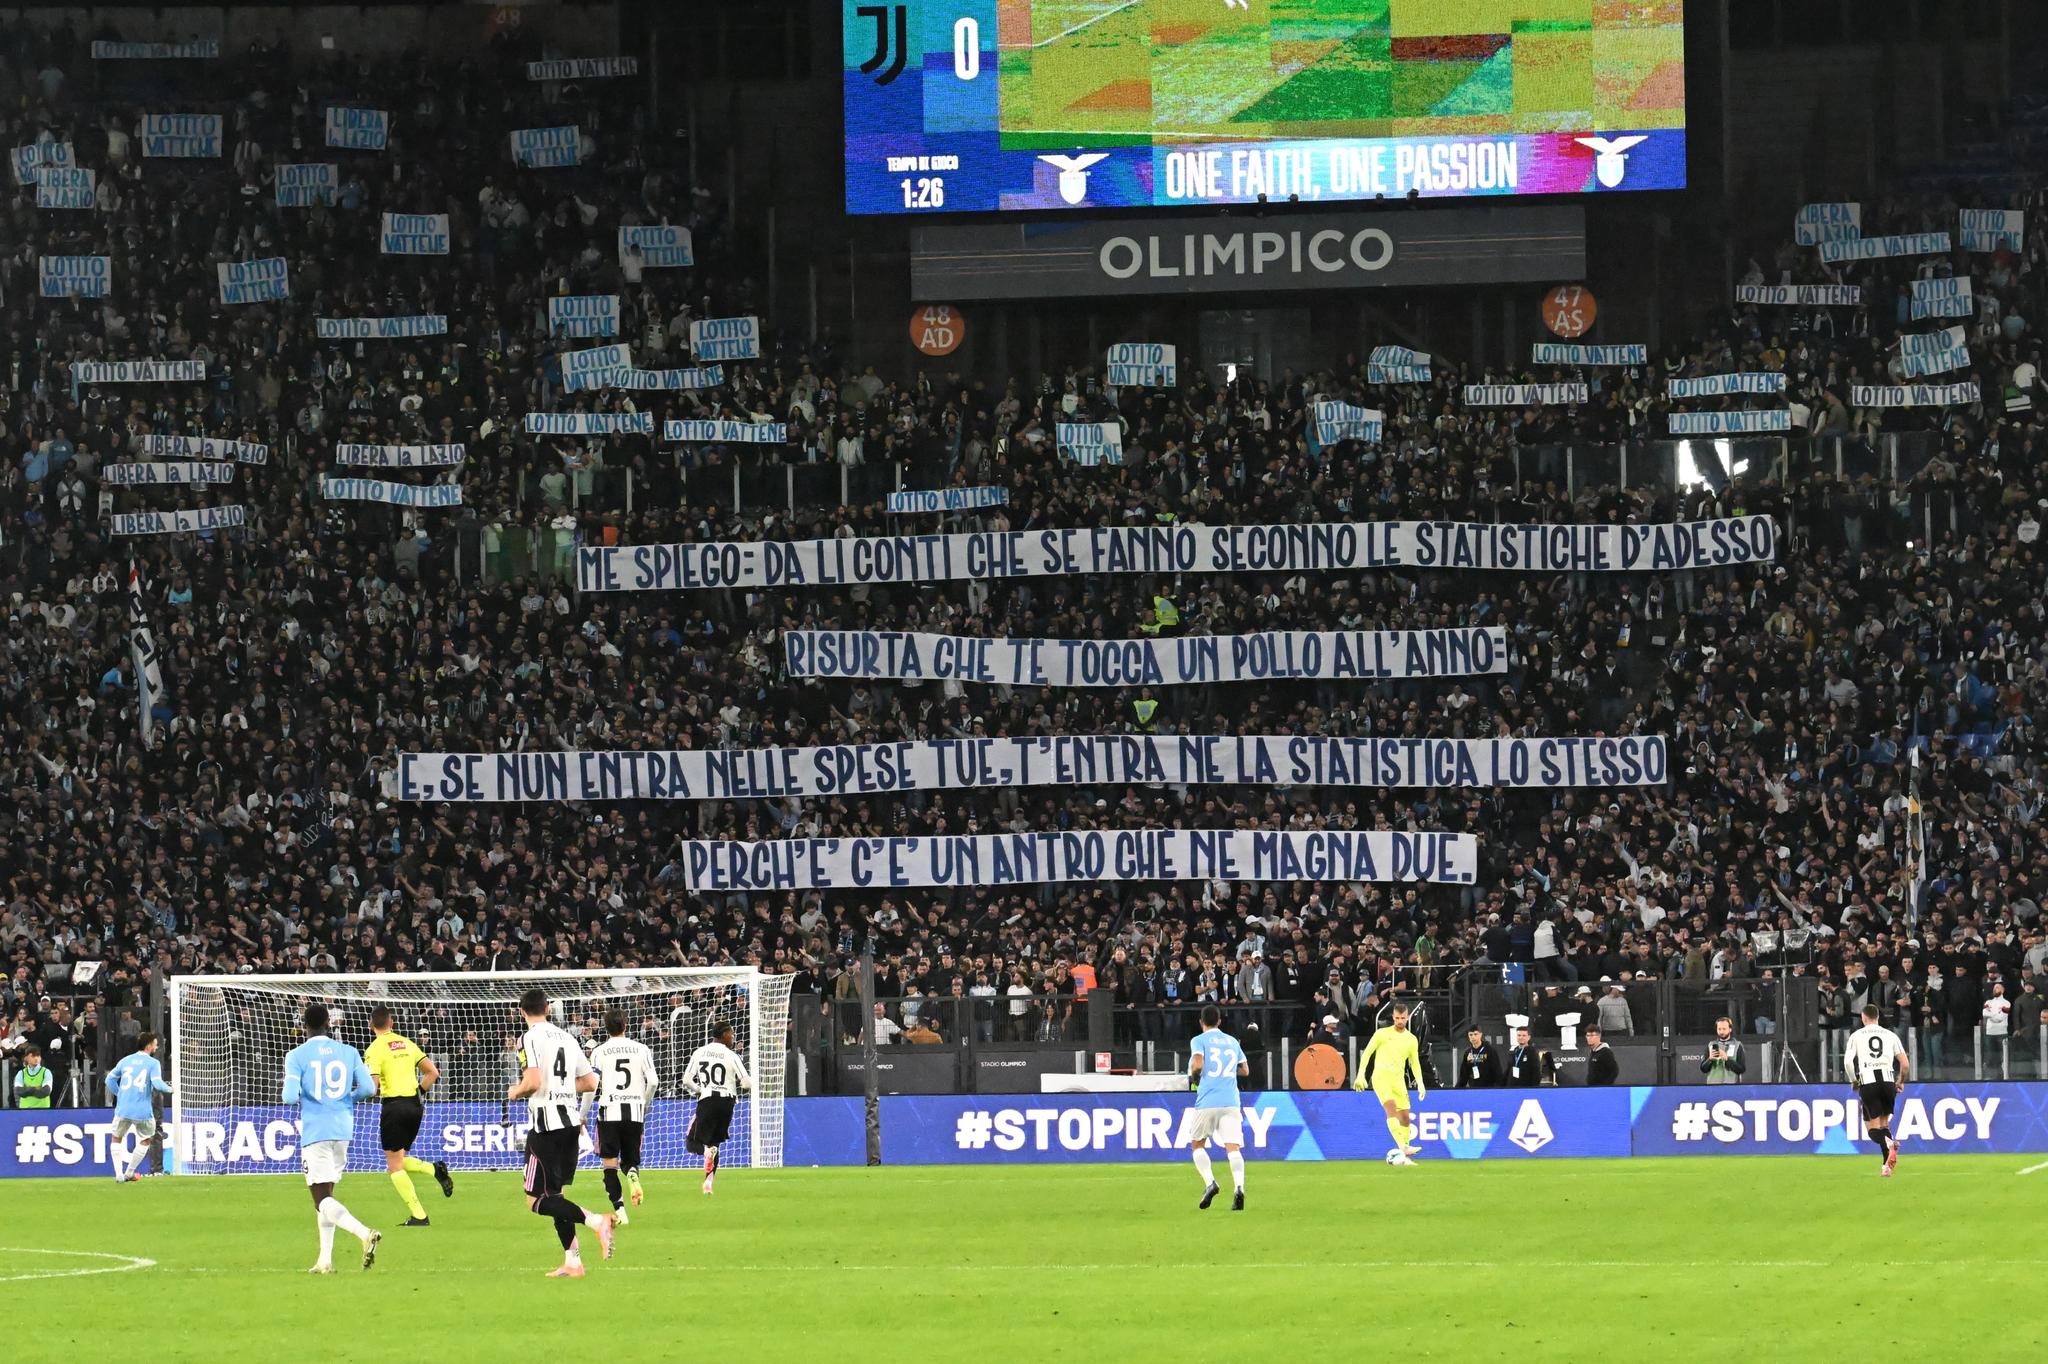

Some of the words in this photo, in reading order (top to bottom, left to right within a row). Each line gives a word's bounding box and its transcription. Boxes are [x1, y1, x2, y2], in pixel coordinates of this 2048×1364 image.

[953, 17, 979, 80] 0
[147, 112, 216, 135] LOTITO
[519, 126, 574, 149] LOTITO
[37, 169, 90, 187] LIBERA
[279, 165, 329, 186] LOTITO
[1165, 152, 1222, 199] ONE
[1233, 148, 1321, 199] FAITH,
[1331, 144, 1387, 193] ONE
[1396, 141, 1518, 190] PASSION
[901, 177, 944, 208] 1:26
[391, 214, 436, 233] LOTITO
[1961, 209, 2006, 230] LOTITO
[623, 226, 676, 246] LOTITO
[1821, 239, 1876, 262] LOTITO
[1882, 232, 1950, 256] VATTENE
[1100, 227, 1394, 279] OLIMPICO
[45, 256, 106, 276] LOTITO
[228, 257, 285, 283] LOTITO
[223, 279, 287, 304] VATTENE
[1554, 286, 1582, 307] 47
[1738, 286, 1788, 303] LOTITO
[1796, 285, 1860, 304] VATTENE
[555, 296, 611, 317] LOTITO
[922, 305, 951, 326] 48
[318, 318, 371, 337] LOTITO
[378, 316, 446, 336] VATTENE
[699, 319, 752, 341] LOTITO
[1554, 309, 1583, 331] AS
[920, 327, 954, 349] AD
[1902, 330, 1953, 356] LOTITO
[570, 346, 620, 371] LOTITO
[1110, 344, 1164, 364] LOTITO
[1535, 344, 1580, 363] LOTITO
[1584, 344, 1646, 363] VATTENE
[1903, 346, 1970, 377] VATTENE
[131, 361, 204, 381] VATTENE
[614, 368, 658, 389] LOTITO
[662, 364, 726, 389] VATTENE
[1465, 385, 1516, 404] LOTITO
[1521, 384, 1587, 403] VATTENE
[1670, 377, 1719, 397] LOTITO
[1722, 372, 1786, 393] VATTENE
[1854, 386, 1905, 405] LOTITO
[1910, 382, 1980, 405] VATTENE
[526, 412, 577, 433] LOTITO
[584, 411, 653, 433] VATTENE
[664, 420, 716, 441] LOTITO
[721, 421, 787, 442] VATTENE
[1670, 413, 1720, 432] LOTITO
[1724, 410, 1790, 432] VATTENE
[1057, 423, 1103, 445] LOTITO
[338, 445, 390, 465] LIBERA
[397, 446, 413, 465] la
[420, 444, 465, 464] LAZIO
[166, 463, 181, 482] la
[189, 463, 234, 482] LAZIO
[324, 479, 384, 500] LOTITO
[390, 484, 461, 506] VATTENE
[887, 491, 938, 512] LOTITO
[943, 486, 1008, 510] VATTENE
[112, 513, 167, 534] LIBERA
[175, 511, 192, 530] la
[198, 506, 244, 529] LAZIO
[580, 546, 621, 591] ME
[764, 541, 806, 585] DA
[818, 540, 844, 583] LI
[853, 535, 952, 583] CONTI
[967, 532, 1029, 577] CHE
[1041, 528, 1081, 573] SE
[1091, 526, 1197, 572] FANNO
[1212, 524, 1358, 571] SECONNO
[1367, 521, 1400, 566] LE
[1416, 521, 1610, 570] STATISTICHE
[1621, 516, 1772, 569] D'ADESSO
[787, 630, 923, 677] RISURTA
[934, 637, 995, 682] CHE
[1007, 638, 1049, 684] TE
[1059, 638, 1163, 685] TOCCA
[1177, 637, 1220, 682] UN
[1232, 632, 1322, 679] POLLO
[497, 752, 568, 800] NUN
[579, 751, 691, 798] ENTRA
[706, 748, 803, 797] NELLE
[813, 742, 916, 793] SPESE
[1178, 736, 1225, 783] NE
[1235, 736, 1278, 783] LA
[1288, 736, 1479, 785] STATISTICA
[1491, 738, 1529, 785] LO
[1539, 735, 1665, 785] STESSO
[930, 834, 980, 885] UN
[992, 832, 1105, 883] ANTRO
[1115, 830, 1178, 880] CHE
[1189, 830, 1239, 879] NE
[1253, 831, 1377, 880] MAGNA
[1392, 833, 1472, 882] DUE.
[1868, 1035, 1884, 1059] 9
[553, 1046, 568, 1087] 4
[615, 1058, 631, 1091] 5
[698, 1061, 727, 1088] 30
[1207, 1047, 1237, 1079] 32
[120, 1066, 148, 1093] 34
[310, 1059, 347, 1100] 19
[955, 1107, 1277, 1151] #STOPIRAY
[1672, 1097, 2001, 1143] #STOPIACY
